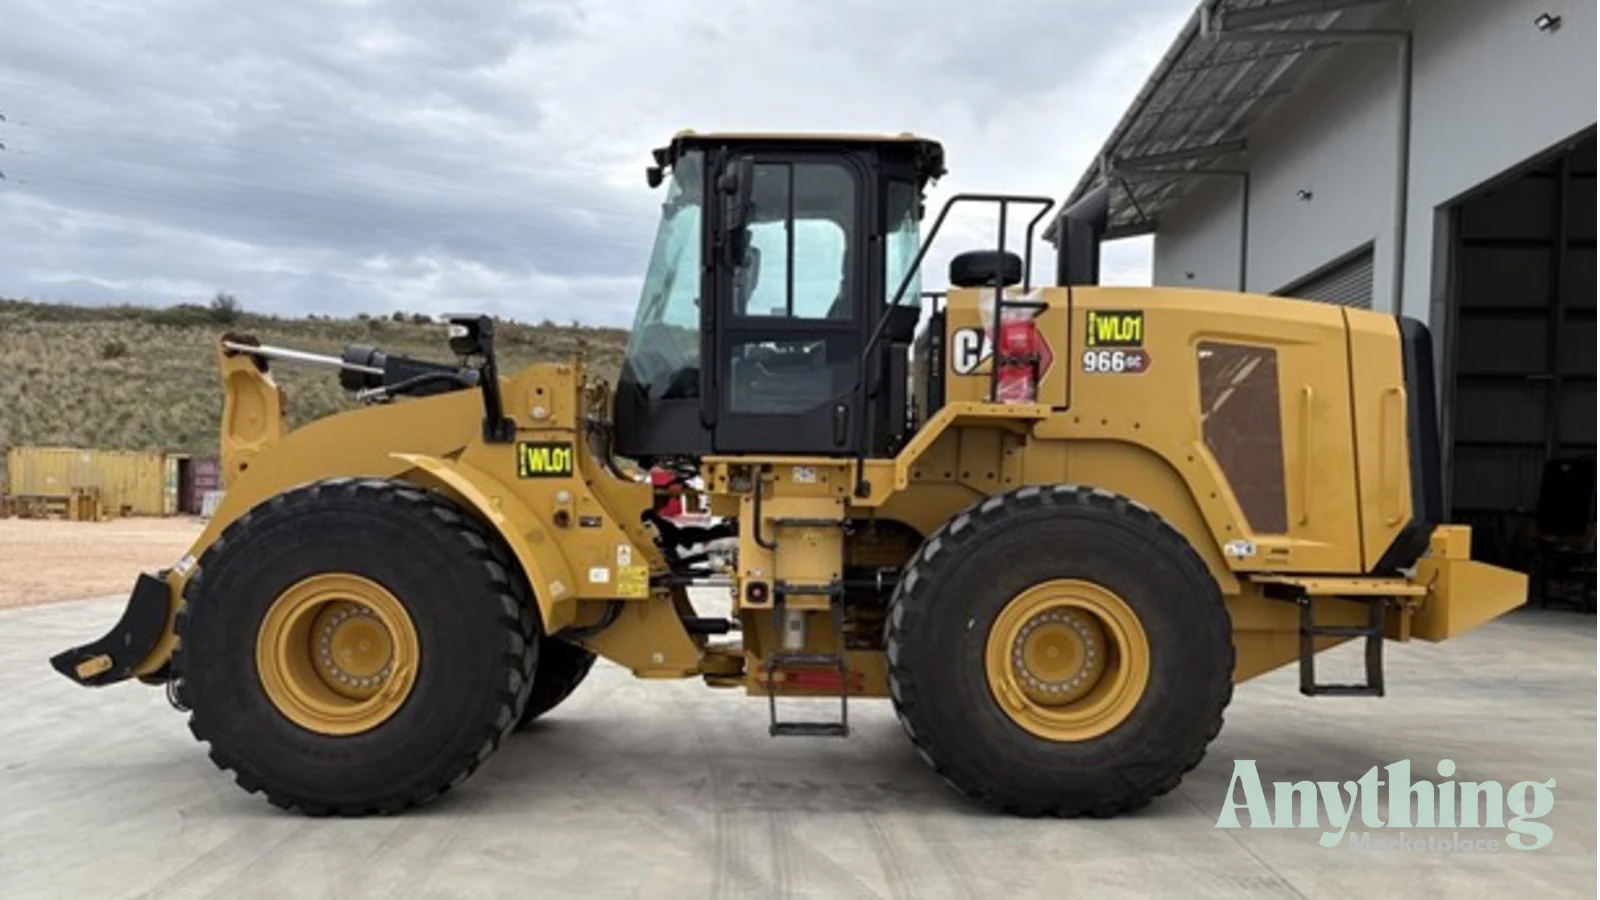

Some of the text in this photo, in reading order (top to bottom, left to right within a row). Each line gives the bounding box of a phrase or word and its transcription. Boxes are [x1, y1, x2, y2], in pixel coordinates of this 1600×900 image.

[1096, 316, 1142, 341] WL01
[953, 329, 995, 374] CA
[1083, 351, 1125, 372] 966
[528, 448, 571, 471] WL01
